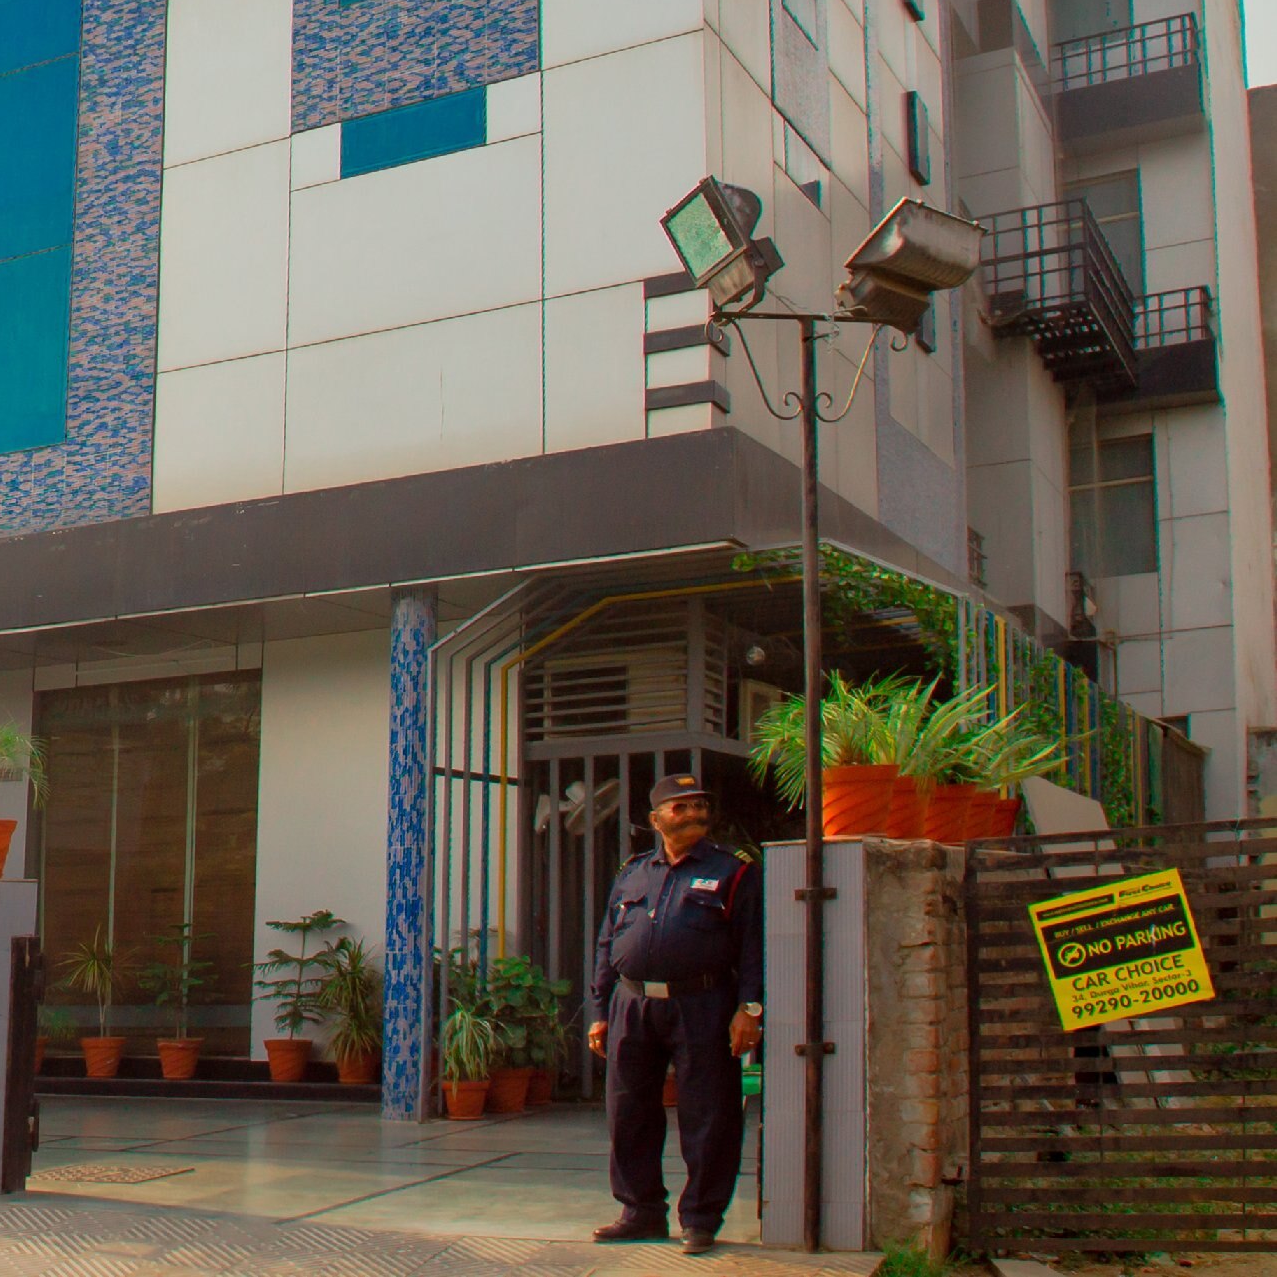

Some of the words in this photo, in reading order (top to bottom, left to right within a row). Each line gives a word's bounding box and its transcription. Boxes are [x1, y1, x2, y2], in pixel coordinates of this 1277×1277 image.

[1054, 929, 1069, 939] BUY
[1075, 924, 1094, 935] SELL
[1158, 903, 1176, 914] CAR
[1086, 938, 1112, 957] NO
[1114, 921, 1187, 951] PARKING
[1072, 972, 1111, 992] CAR
[1114, 954, 1185, 982] CHOICE
[1071, 979, 1200, 1019] 99290-20000
